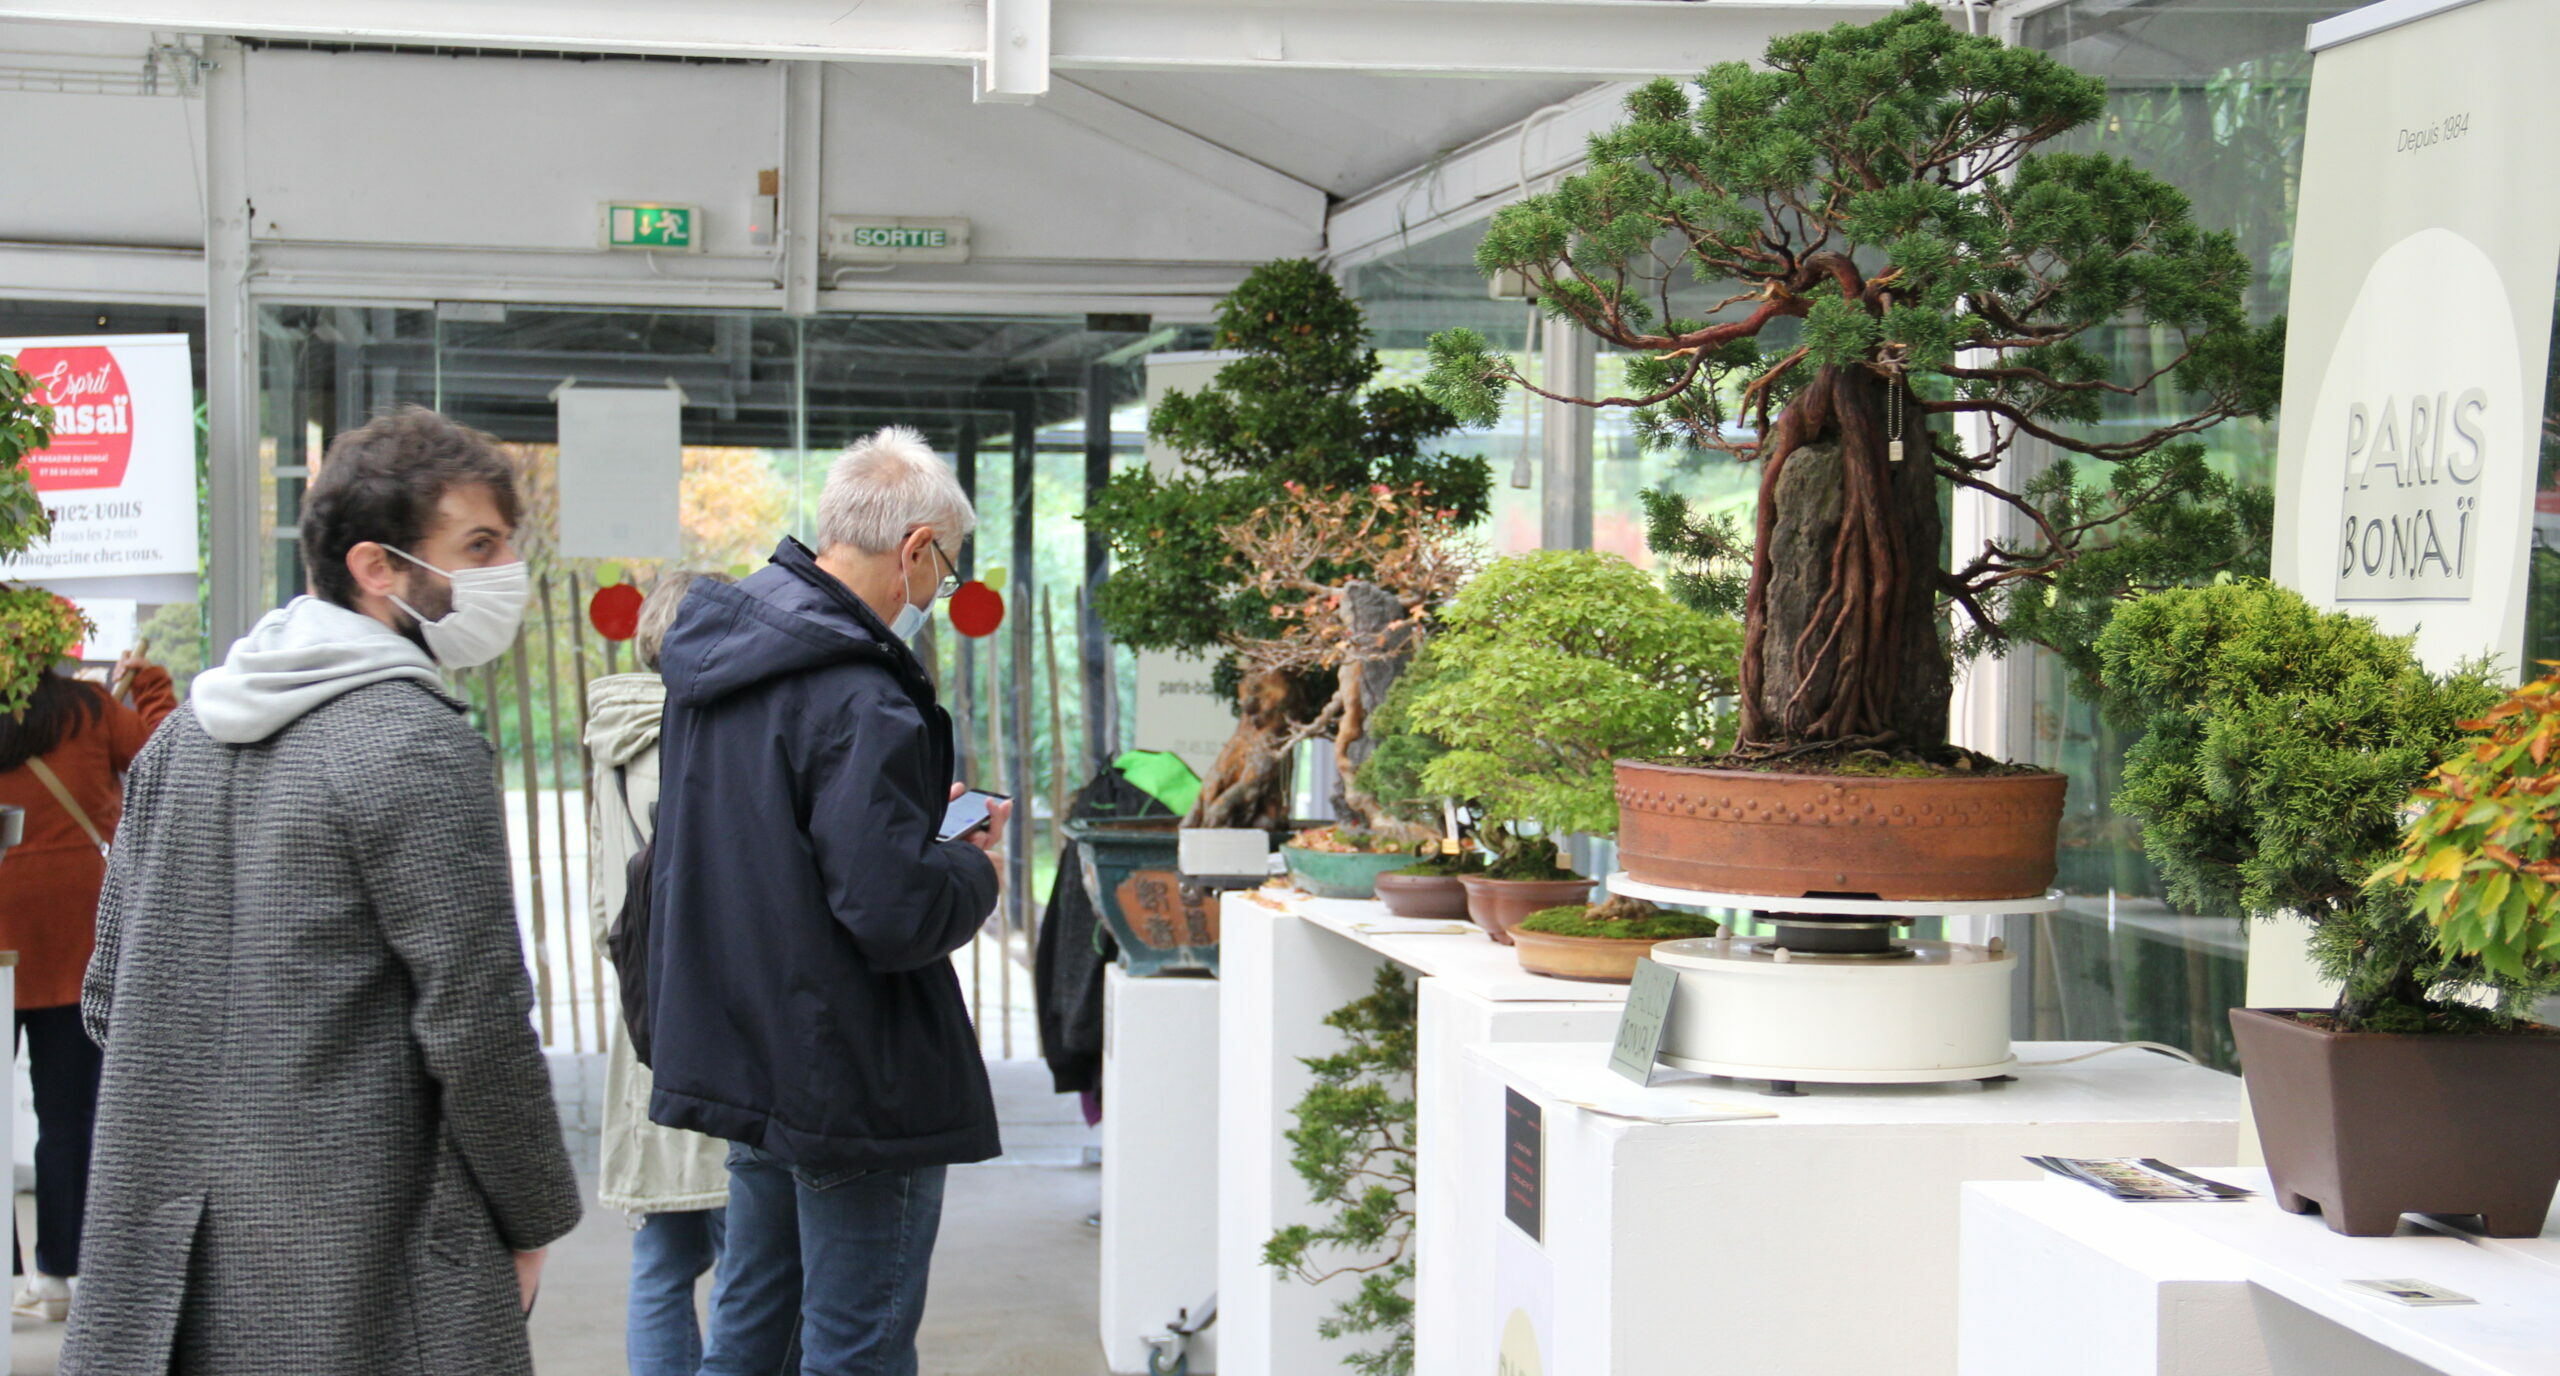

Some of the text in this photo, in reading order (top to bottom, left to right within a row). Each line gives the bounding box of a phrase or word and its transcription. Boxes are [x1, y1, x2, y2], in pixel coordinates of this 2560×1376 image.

[2397, 112, 2470, 155] Depuis 1984
[855, 228, 945, 247] SORTIE
[36, 360, 111, 404] Esprit
[2344, 387, 2488, 491] PARIS
[44, 501, 142, 522] nez-vous
[87, 528, 102, 541] les
[2342, 497, 2475, 580] BONSAÏ
[19, 547, 163, 567] magazine chez vous.
